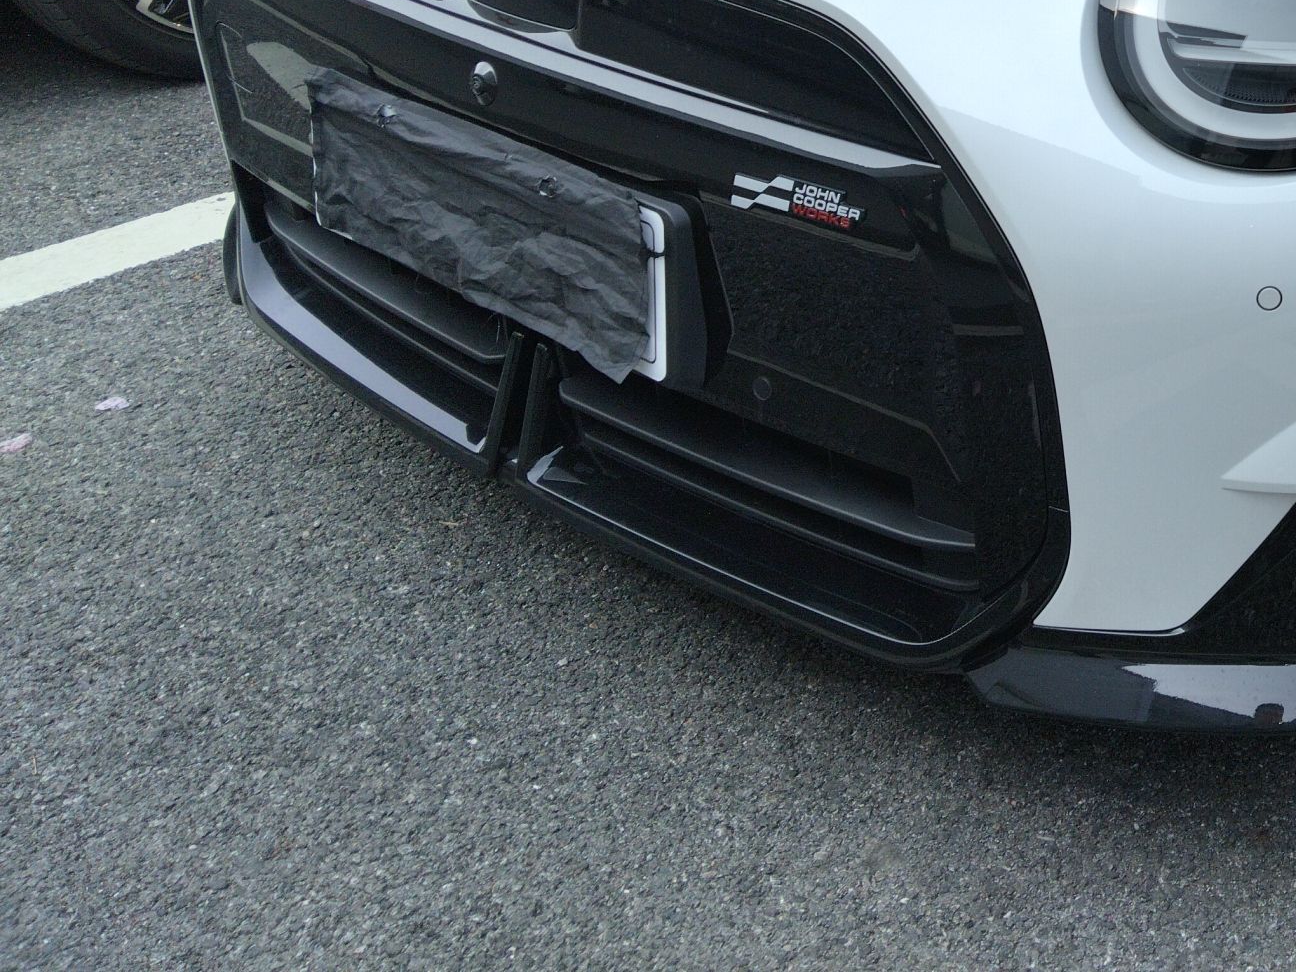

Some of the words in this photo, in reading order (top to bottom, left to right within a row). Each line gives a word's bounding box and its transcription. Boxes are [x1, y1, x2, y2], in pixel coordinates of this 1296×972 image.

[794, 183, 841, 204] JOHN
[792, 193, 860, 221] COOPER
[792, 203, 851, 229] WORKS
